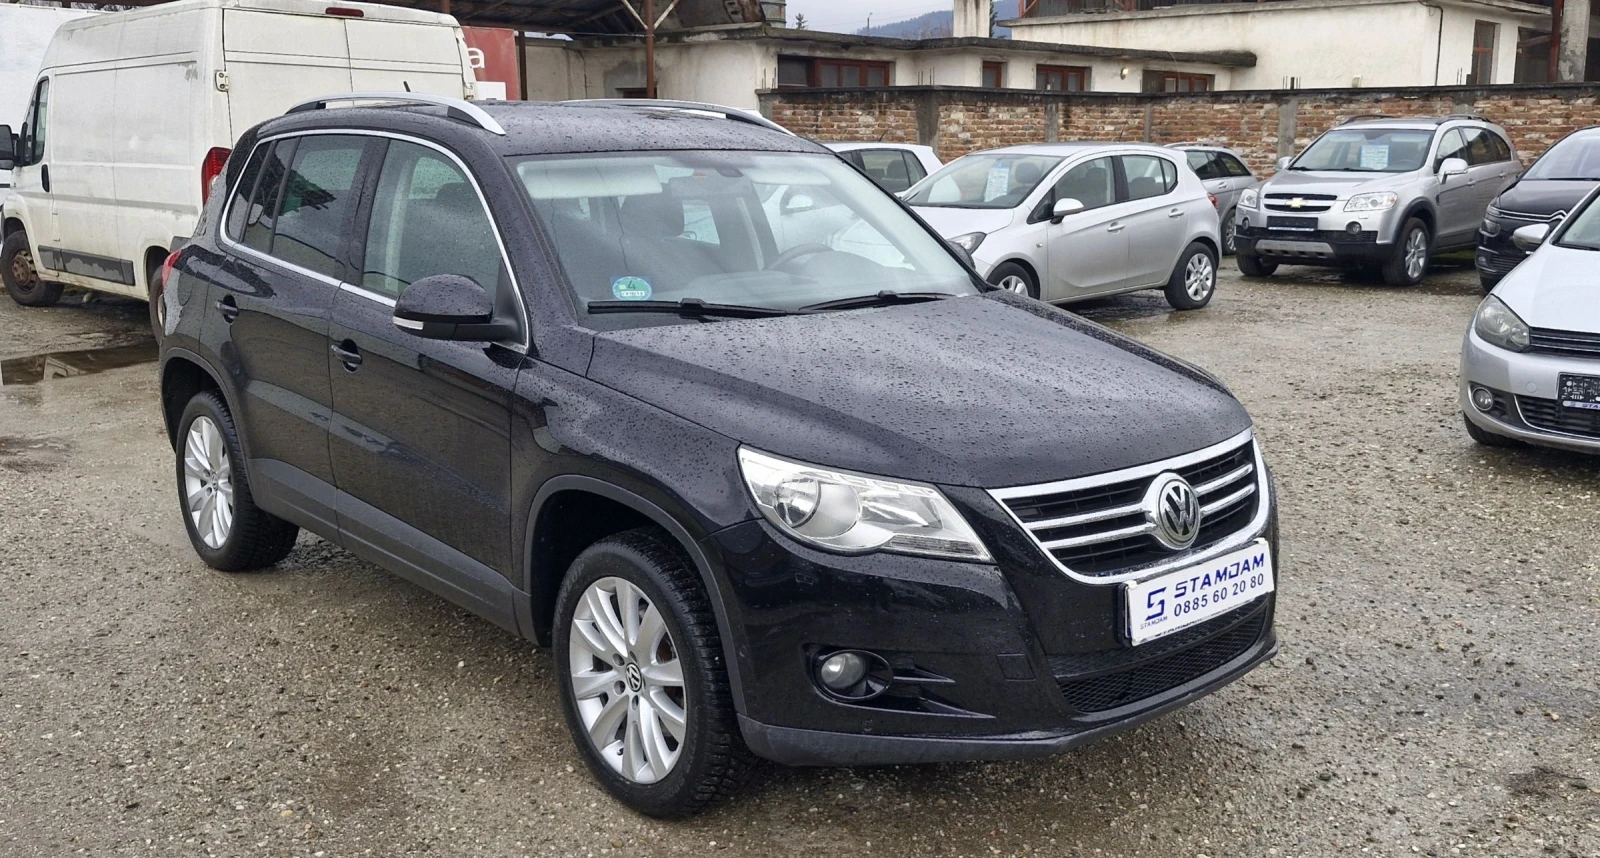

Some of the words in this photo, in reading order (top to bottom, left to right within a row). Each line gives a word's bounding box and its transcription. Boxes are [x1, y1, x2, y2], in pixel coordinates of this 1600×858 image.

[627, 280, 637, 290] 4
[1174, 594, 1208, 617] 0885
[1213, 587, 1228, 603] 60
[1232, 579, 1246, 596] 20
[1250, 573, 1264, 588] 80
